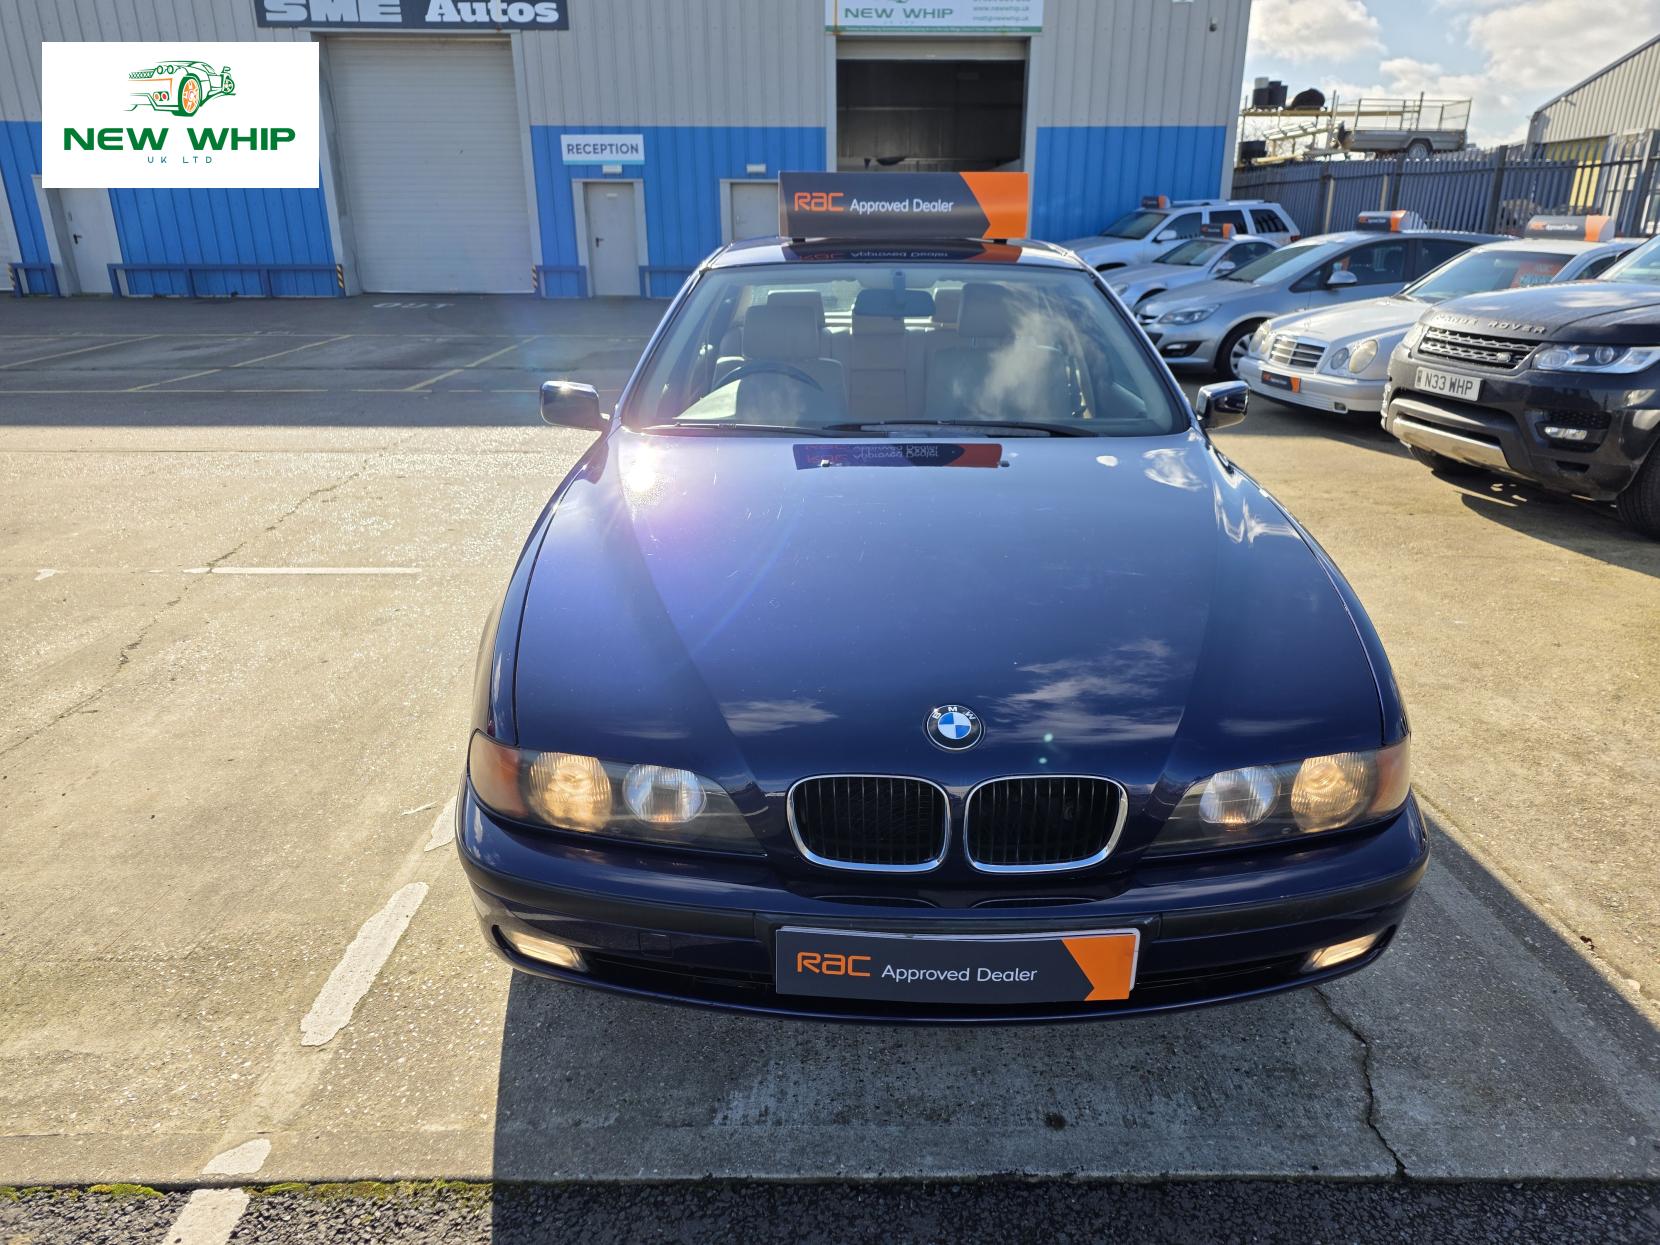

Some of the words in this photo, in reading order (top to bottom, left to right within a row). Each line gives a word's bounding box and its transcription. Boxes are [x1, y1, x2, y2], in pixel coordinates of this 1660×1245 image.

[265, 0, 402, 22] SME
[425, 0, 559, 23] Autos
[844, 8, 894, 19] NEW
[903, 8, 954, 19] WHIP
[566, 143, 640, 155] RECEPTION
[849, 198, 909, 214] Approved
[912, 199, 954, 212] Dealer
[1487, 320, 1548, 335] ROVER
[1424, 371, 1447, 390] N33
[1449, 376, 1474, 396] WHP
[931, 706, 977, 720] BMW
[881, 964, 970, 983] Approved
[977, 967, 1038, 982] Dealer
